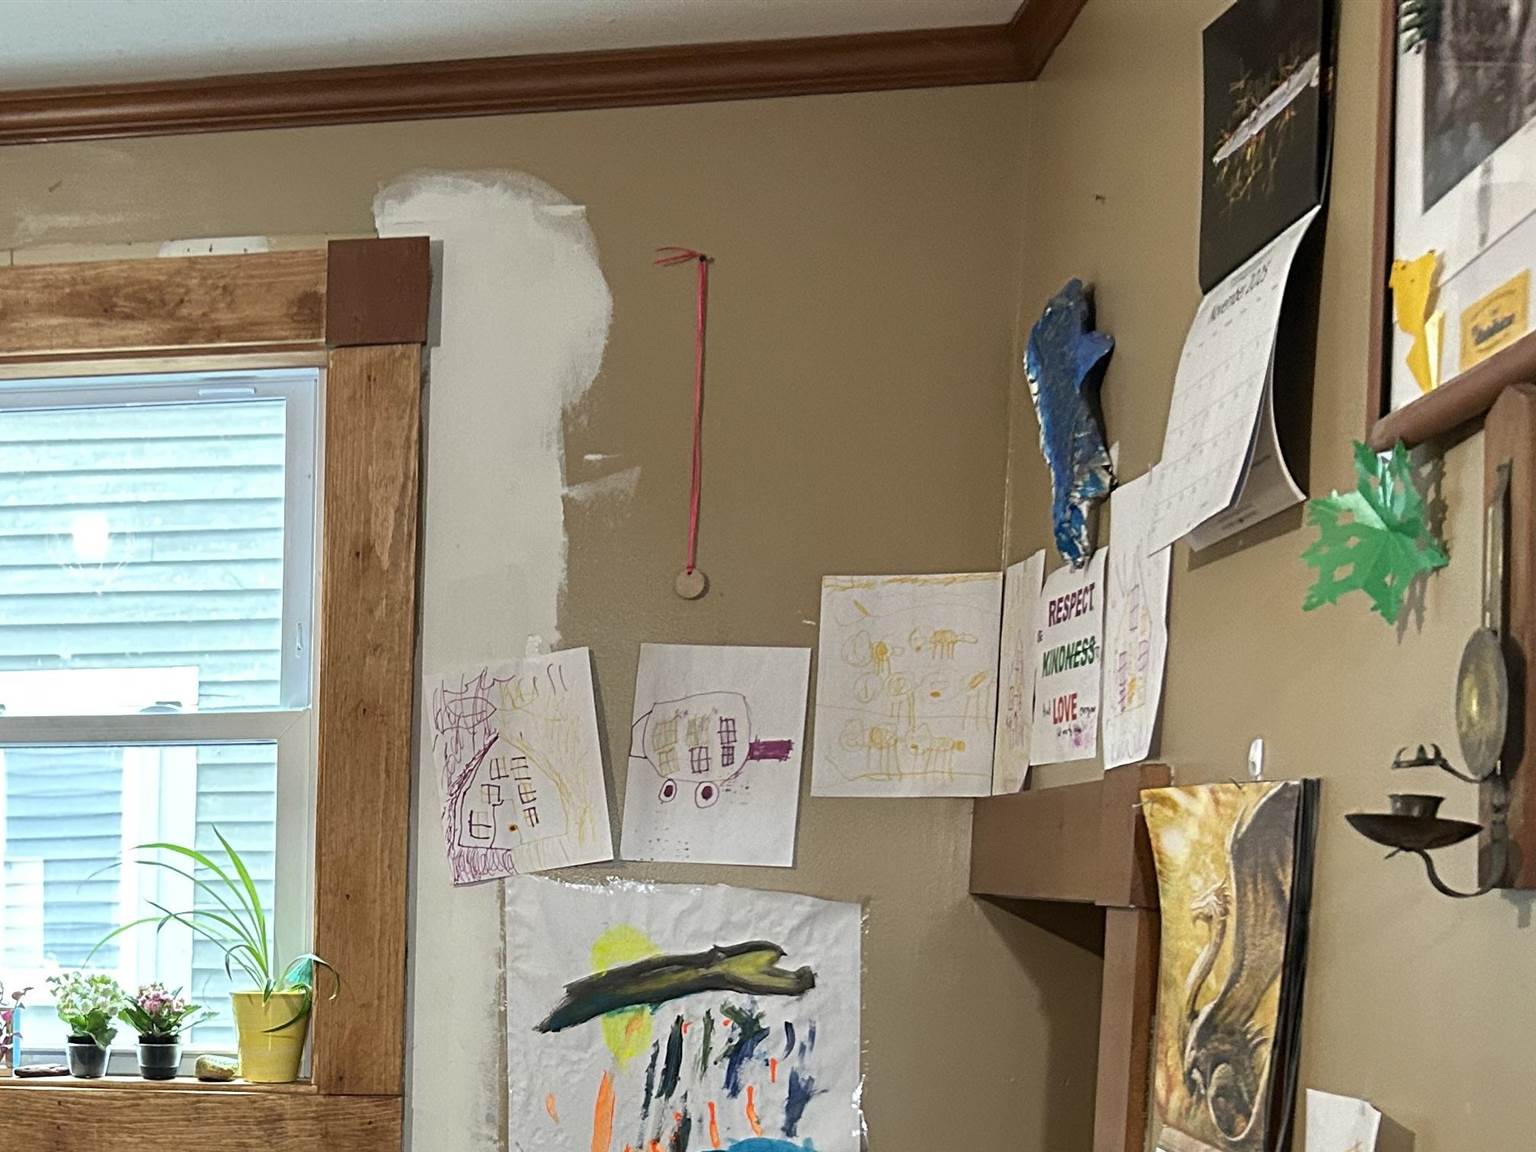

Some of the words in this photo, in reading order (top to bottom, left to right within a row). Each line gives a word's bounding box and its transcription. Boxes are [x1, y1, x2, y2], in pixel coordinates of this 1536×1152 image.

[1048, 582, 1096, 627] RESPECT
[1042, 637, 1096, 677] KINDNESS
[1052, 692, 1078, 725] LOVE
